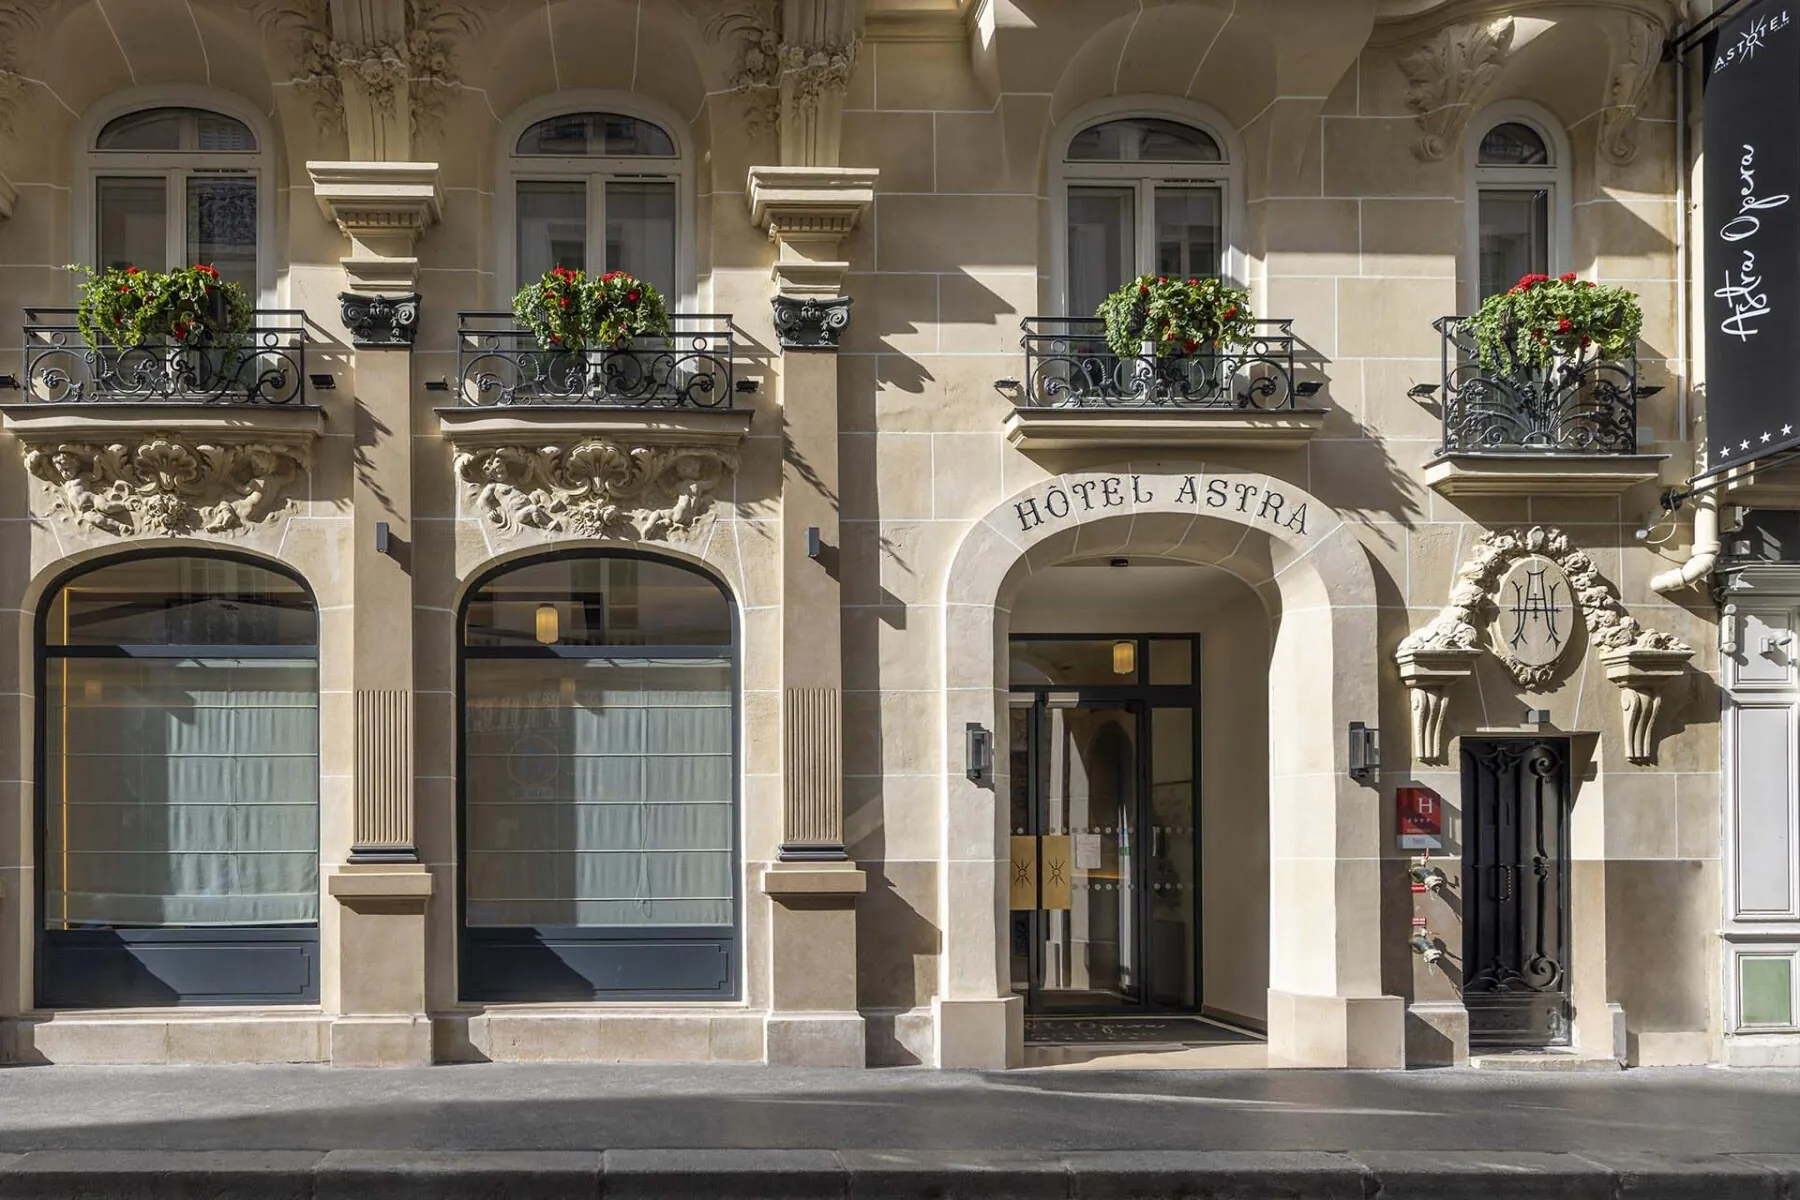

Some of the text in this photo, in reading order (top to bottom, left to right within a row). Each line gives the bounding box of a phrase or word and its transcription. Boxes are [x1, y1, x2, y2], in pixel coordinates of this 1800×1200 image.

[1714, 10, 1790, 70] ASTOTEL
[1714, 144, 1790, 343] Astra Opera
[1013, 474, 1309, 535] HÔTEL ASTRA
[1418, 797, 1434, 814] H
